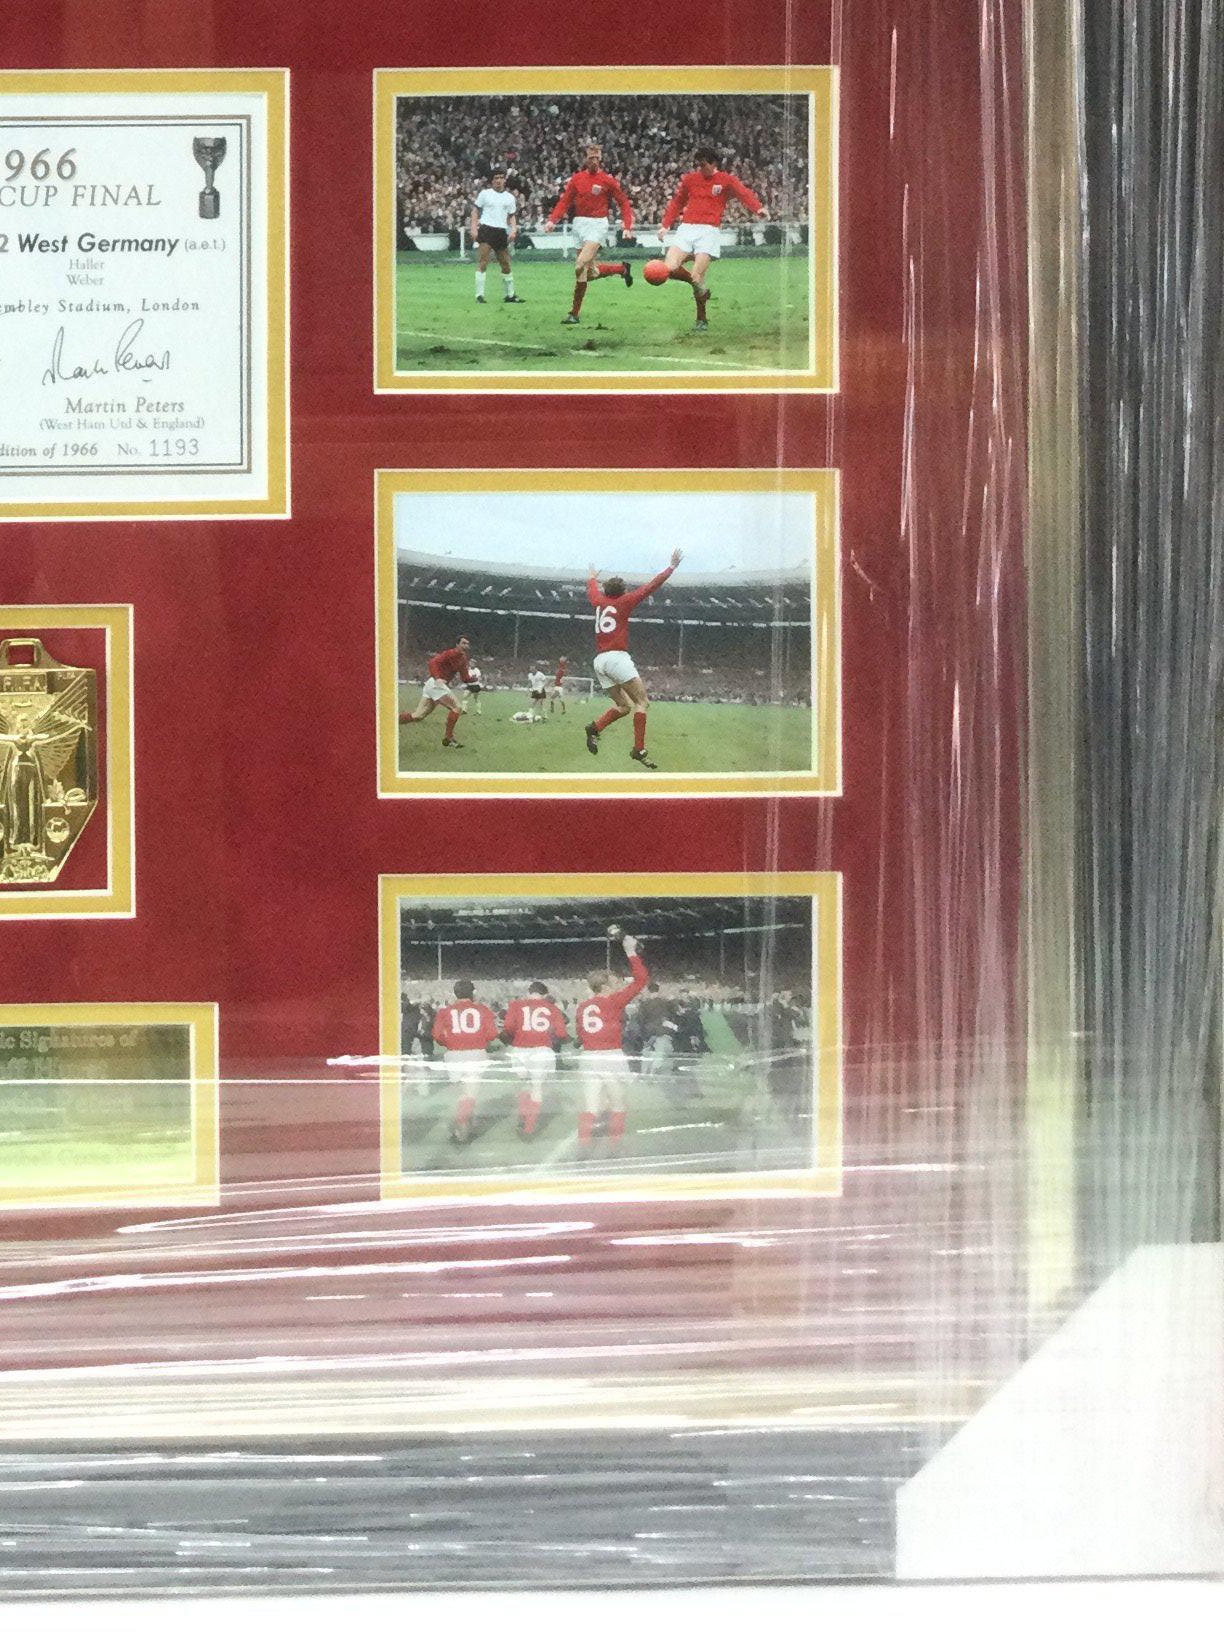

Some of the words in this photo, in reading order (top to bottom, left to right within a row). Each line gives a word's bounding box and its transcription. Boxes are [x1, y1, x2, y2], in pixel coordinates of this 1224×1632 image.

[71, 184, 162, 206] FINAL
[18, 232, 68, 253] West
[77, 232, 180, 257] Germany
[69, 258, 105, 270] Haller
[66, 273, 104, 286] Weber
[58, 298, 131, 313] Stadium,
[141, 297, 200, 312] London
[64, 397, 127, 414] Martin
[134, 396, 185, 414] Peters
[39, 417, 73, 431] (West
[76, 418, 105, 430] Ham
[109, 418, 133, 430] Utd
[135, 417, 148, 430] &
[153, 416, 206, 432] England)
[42, 443, 57, 459] of
[63, 442, 99, 457] 1966
[149, 437, 201, 457] 1193
[594, 605, 618, 634] 16
[450, 1008, 481, 1034] 10
[521, 1006, 551, 1032] 16
[582, 1005, 603, 1033] 6
[119, 1029, 140, 1048] of
